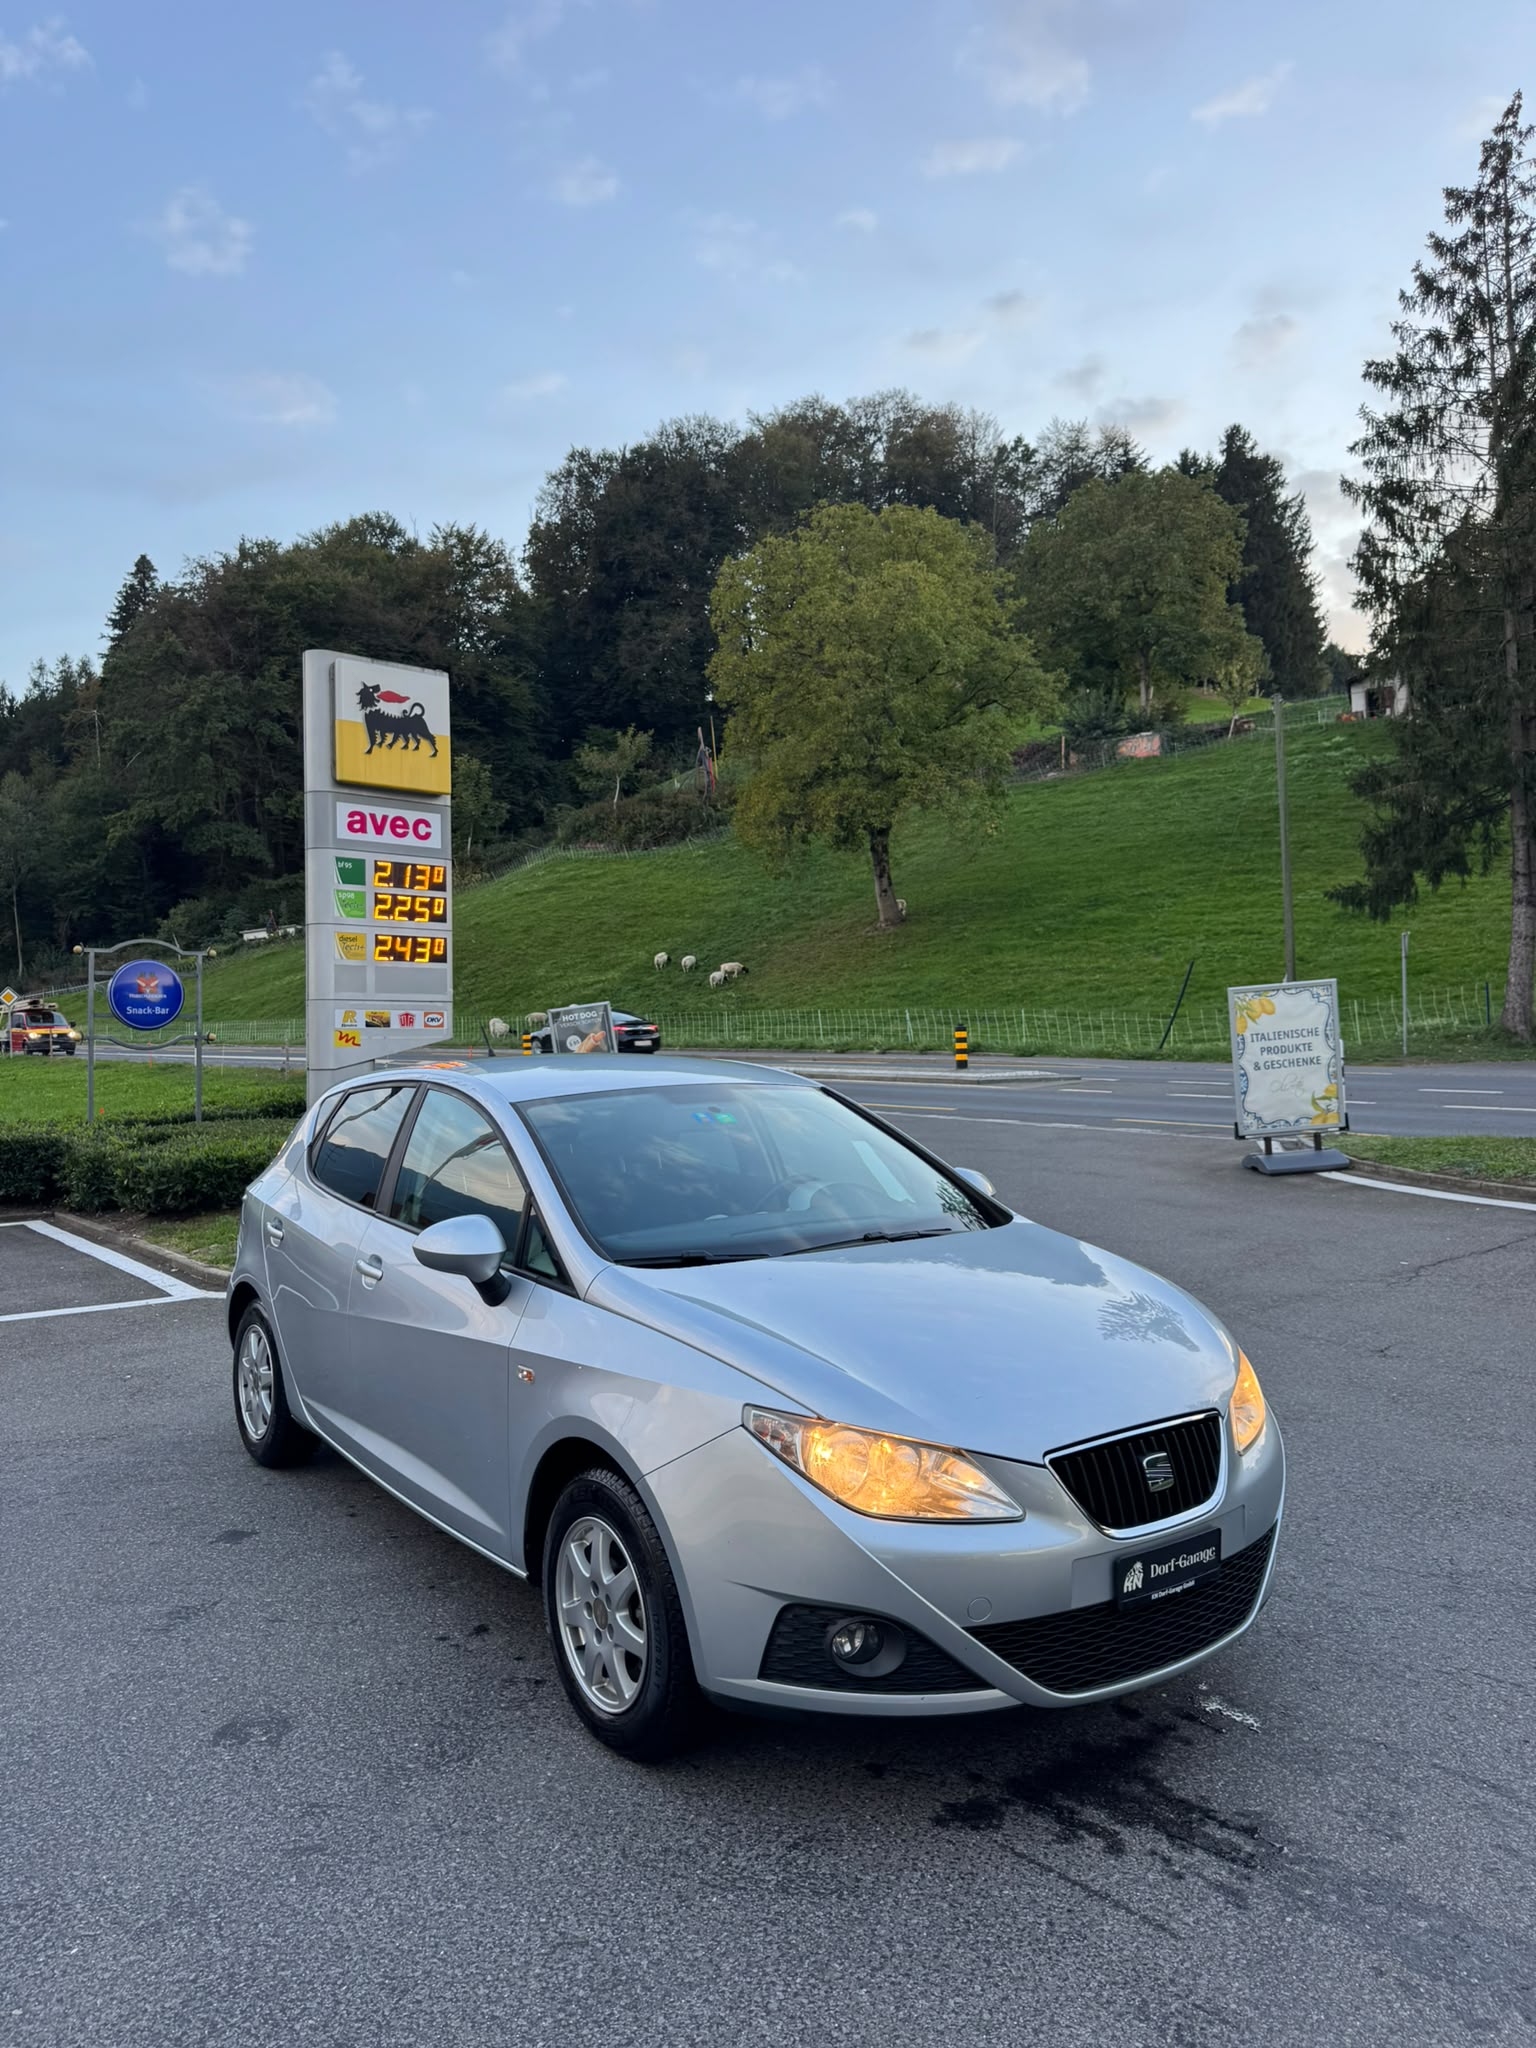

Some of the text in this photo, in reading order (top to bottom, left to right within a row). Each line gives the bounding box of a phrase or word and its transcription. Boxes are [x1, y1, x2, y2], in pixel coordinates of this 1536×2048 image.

[346, 810, 432, 841] avec
[338, 935, 358, 943] diesel
[126, 1006, 169, 1015] Snack-Bar
[562, 1010, 598, 1022] HOT DOG
[1250, 1027, 1320, 1043] ITALIENISCHE
[1260, 1042, 1313, 1056] PRODUKTE
[1253, 1056, 1322, 1071] & GESCHENKE
[1150, 1546, 1216, 1578] Dorf-Garage
